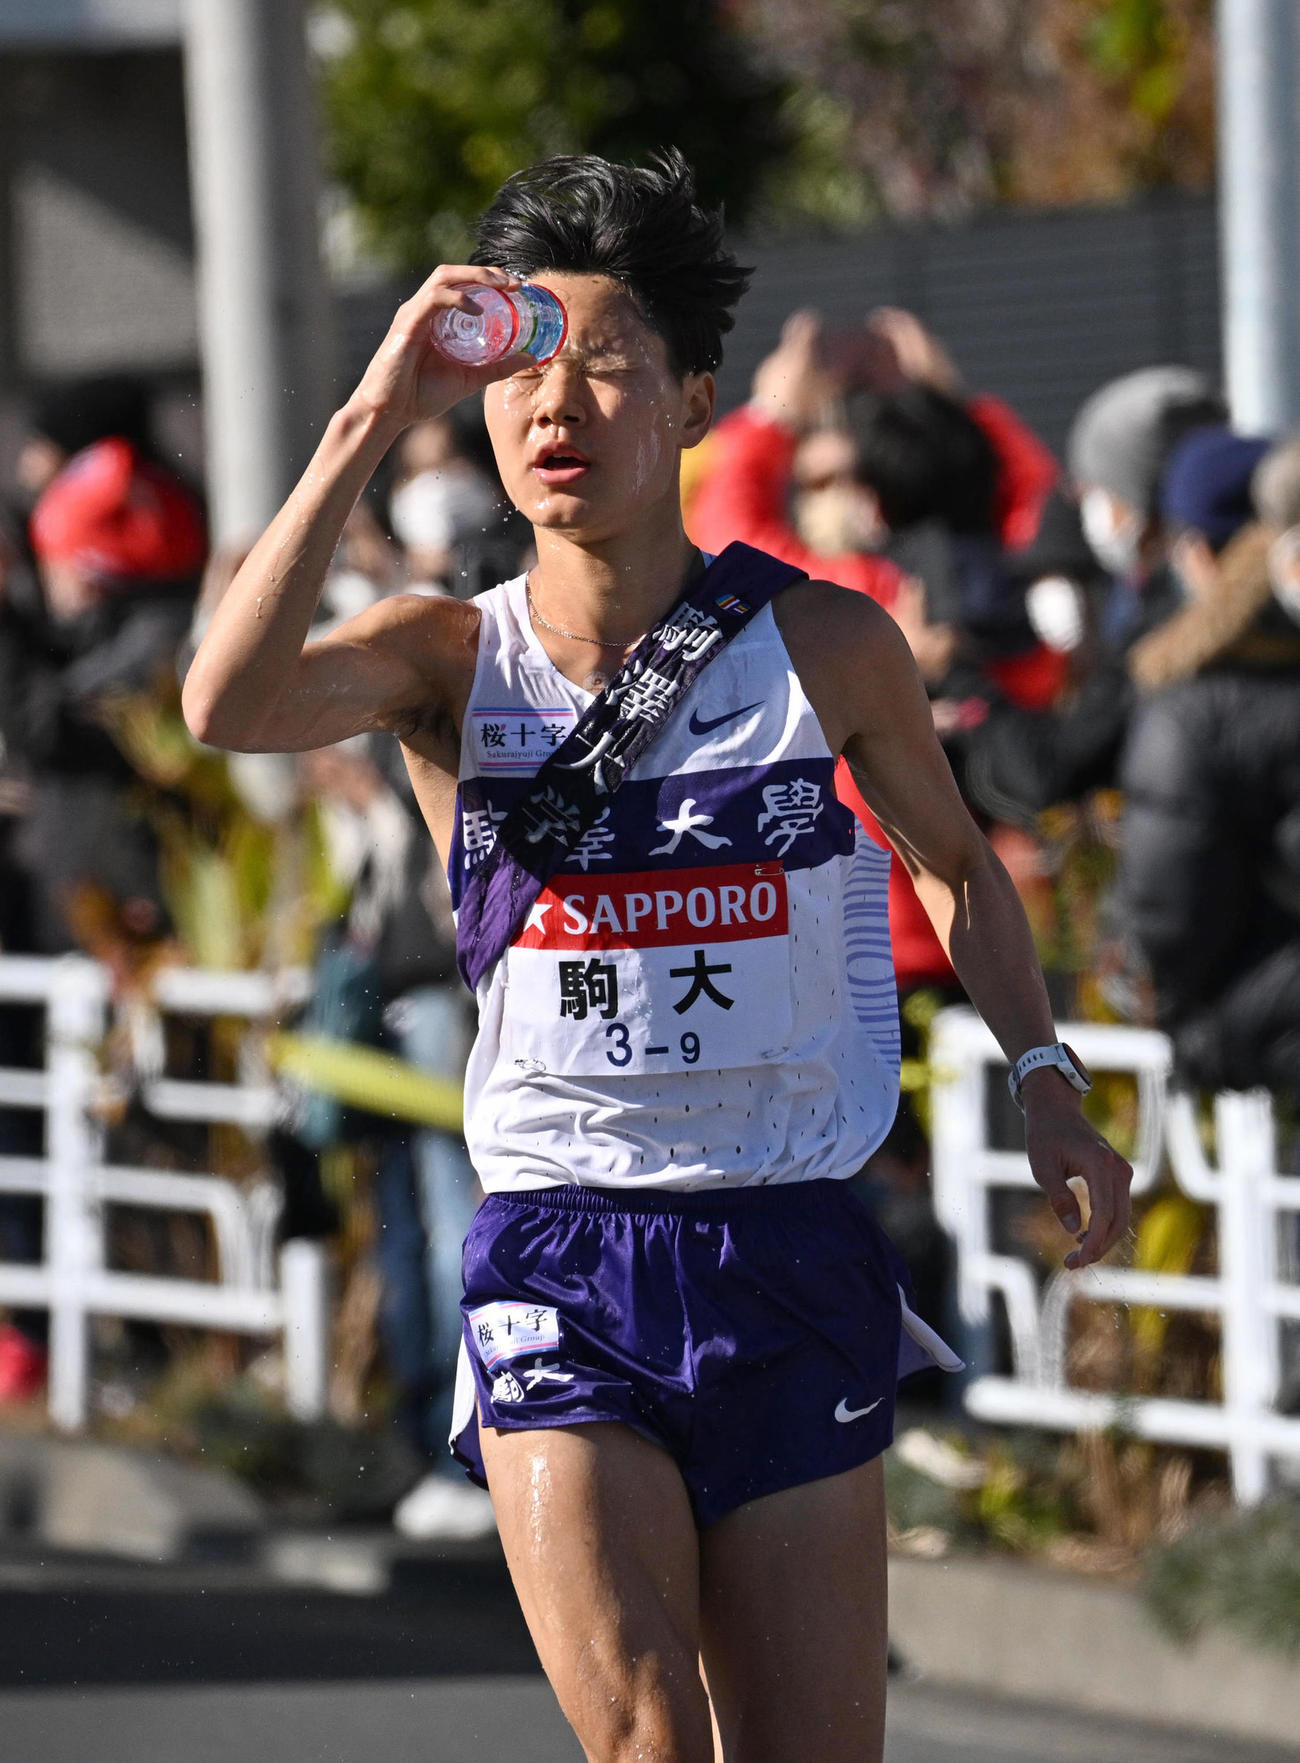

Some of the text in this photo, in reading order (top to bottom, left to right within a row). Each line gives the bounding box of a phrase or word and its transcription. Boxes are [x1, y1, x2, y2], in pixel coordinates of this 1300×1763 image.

[480, 723, 567, 747] 桜十字
[563, 881, 777, 935] SAPPORO
[605, 1022, 700, 1067] 3-9
[477, 1308, 548, 1347] 桜十字
